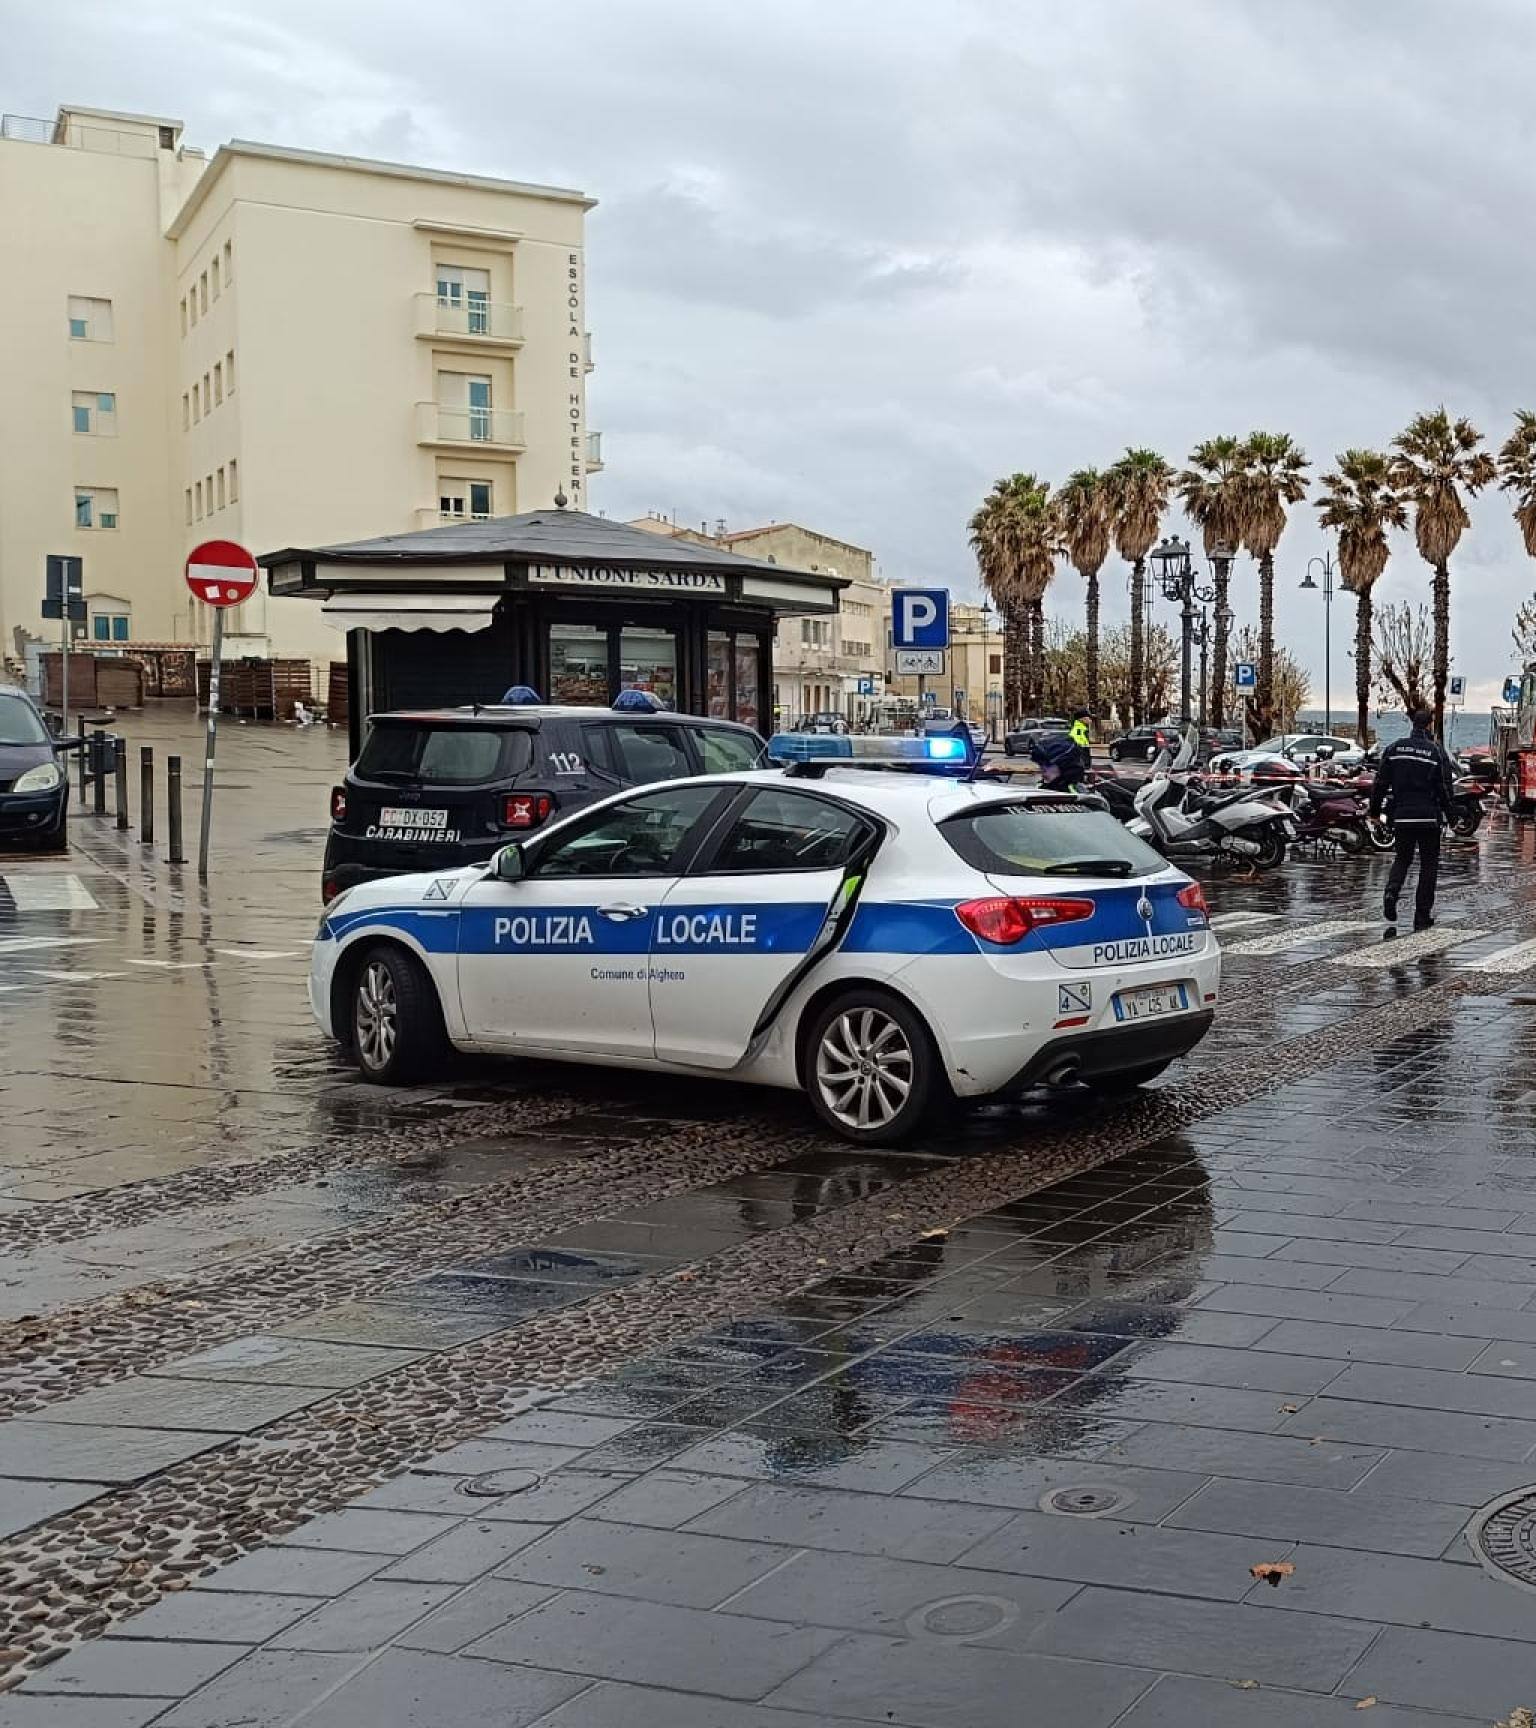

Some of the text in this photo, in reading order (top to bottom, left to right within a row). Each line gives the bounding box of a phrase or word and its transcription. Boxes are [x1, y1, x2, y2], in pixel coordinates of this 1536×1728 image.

[569, 353, 578, 378] DE
[569, 394, 581, 511] HOTELERI
[648, 567, 722, 589] SARDA
[903, 596, 937, 642] P
[1238, 666, 1252, 684] P
[550, 751, 583, 771] 112
[366, 825, 462, 843] CARABINIERI
[494, 914, 757, 945] POLIZIA LOCALE
[1094, 934, 1194, 964] POLIZIA LOCALE
[590, 968, 634, 981] Comune
[637, 968, 648, 981] di
